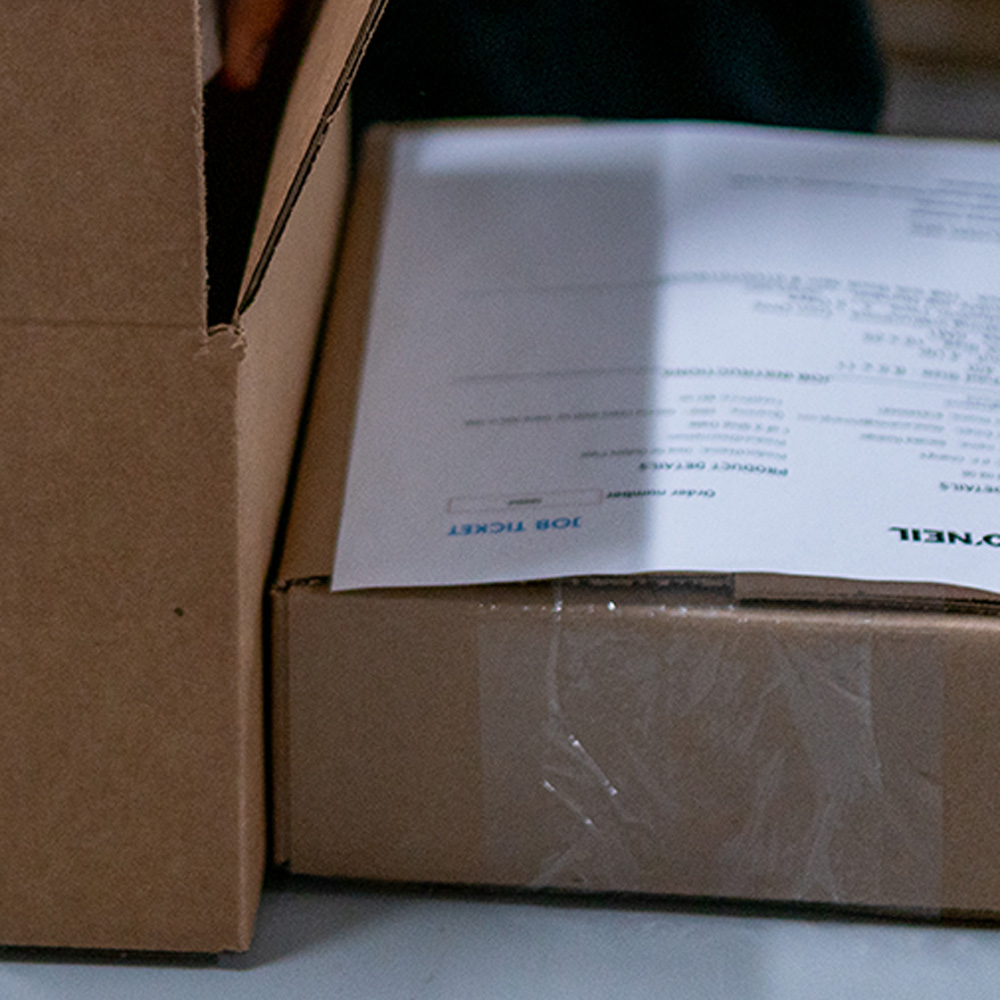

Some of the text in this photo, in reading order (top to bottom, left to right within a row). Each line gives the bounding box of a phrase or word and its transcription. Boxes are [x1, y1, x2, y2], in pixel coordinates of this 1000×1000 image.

[638, 460, 789, 477] PRODUCT DETAILS
[606, 488, 716, 499] Order number
[448, 516, 581, 537] JOB TICKET
[888, 526, 1000, 547] O'NEIL
